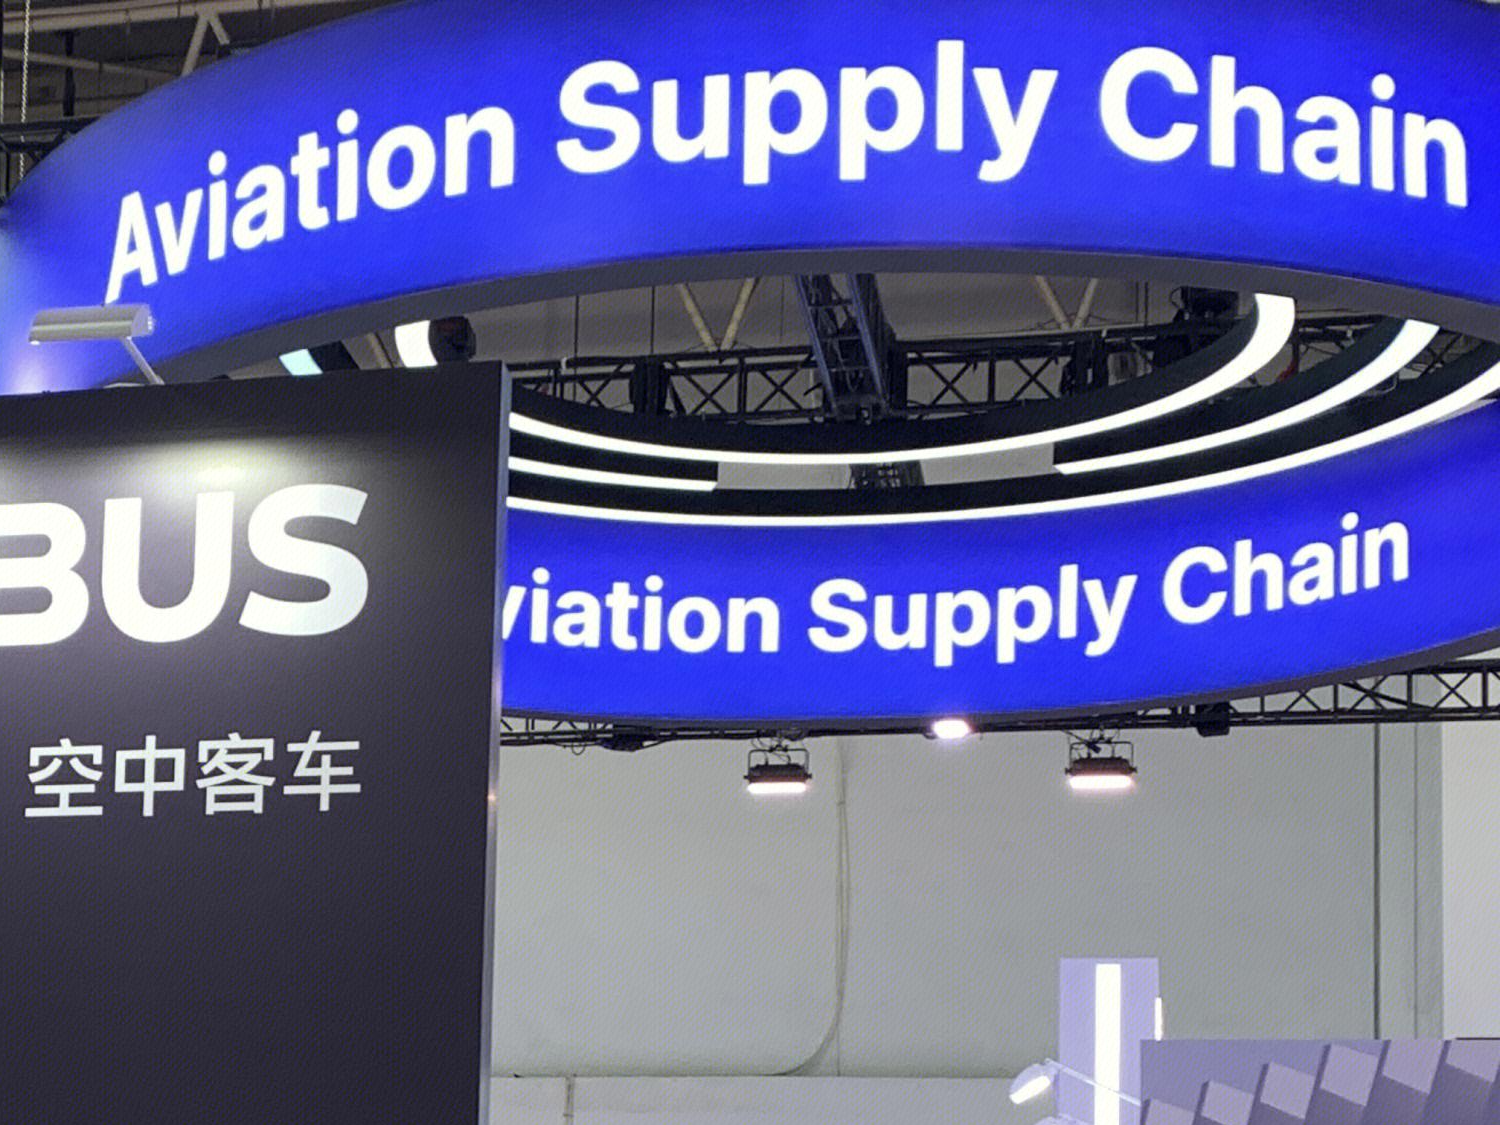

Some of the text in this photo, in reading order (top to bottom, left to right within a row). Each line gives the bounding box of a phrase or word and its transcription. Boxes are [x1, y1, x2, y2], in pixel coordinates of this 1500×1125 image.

[105, 39, 1468, 304] Aviation Supply Chain
[808, 563, 1138, 667] Supply
[1162, 511, 1409, 624] Chain
[25, 730, 362, 819] 空中客车
